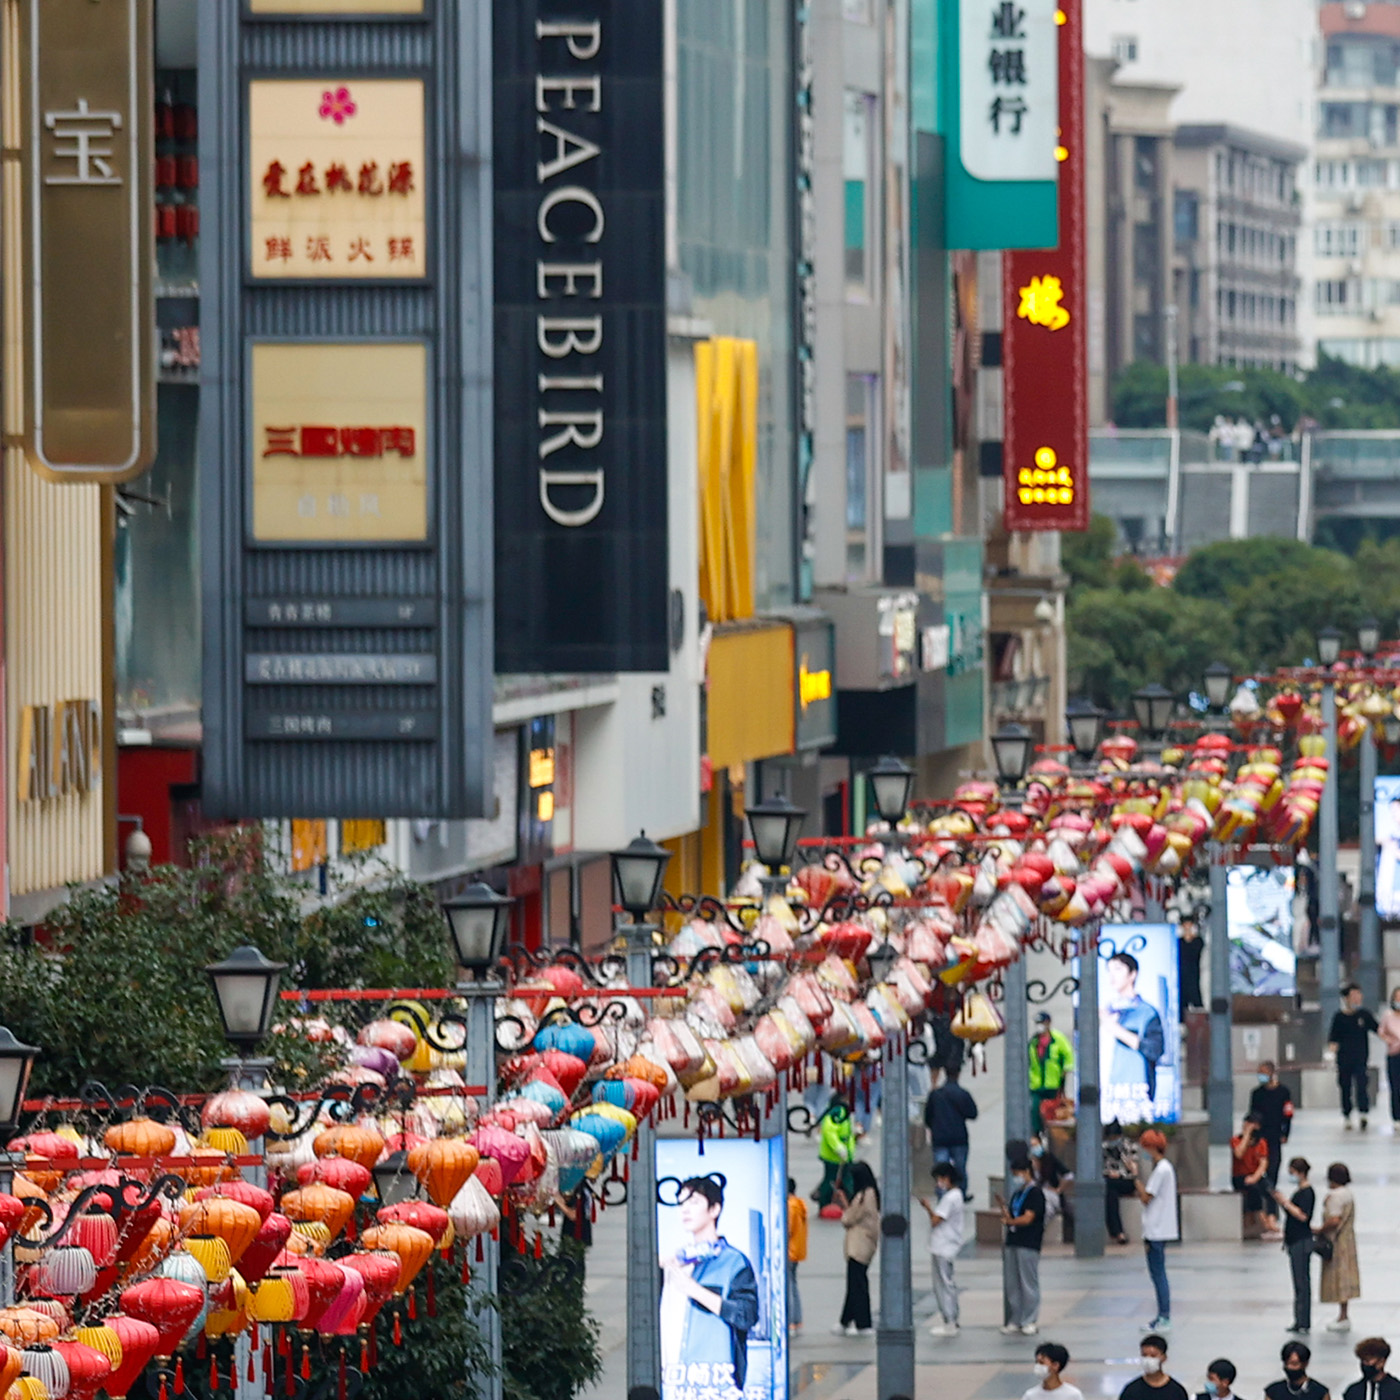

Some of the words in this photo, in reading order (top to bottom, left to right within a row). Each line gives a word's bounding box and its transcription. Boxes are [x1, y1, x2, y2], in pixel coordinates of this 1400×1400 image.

[988, 2, 1029, 136] 业银行
[45, 98, 122, 184] 宝
[536, 20, 605, 527] PEACEBIRD
